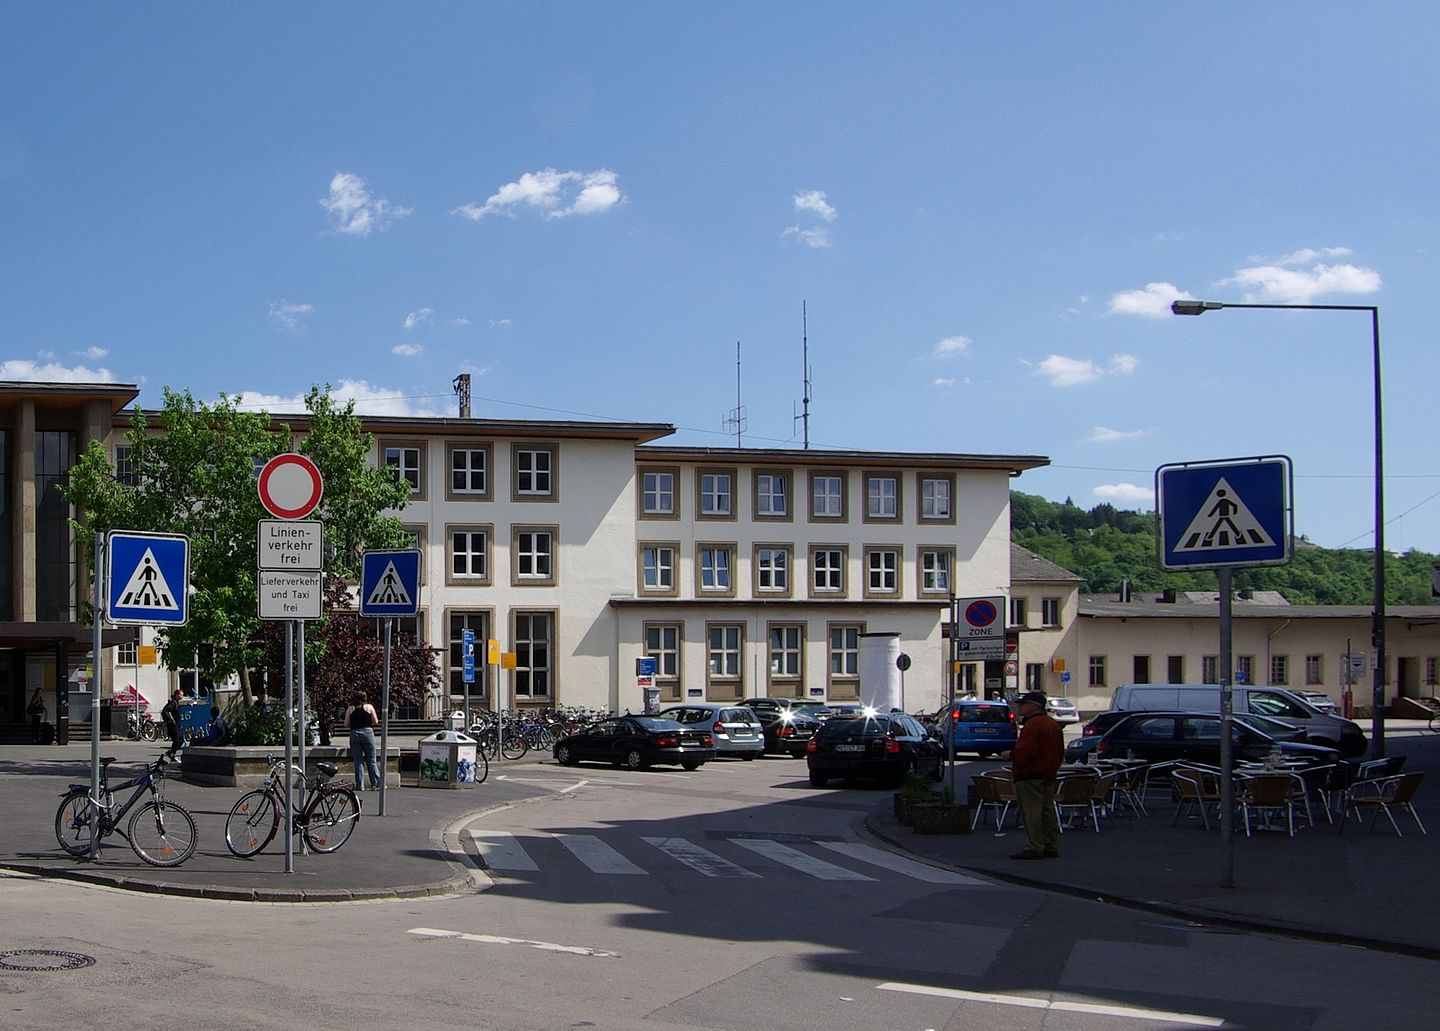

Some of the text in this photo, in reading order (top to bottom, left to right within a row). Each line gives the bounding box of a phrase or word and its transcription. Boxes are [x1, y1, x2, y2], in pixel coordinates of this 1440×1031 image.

[271, 526, 311, 537] Linien-
[268, 540, 313, 550] verkehr
[281, 553, 301, 564] frei
[261, 576, 319, 586] Lieferverkehr
[271, 590, 310, 599] und Taxi
[283, 603, 298, 612] frei
[968, 627, 993, 636] ZONE
[961, 642, 968, 650] P
